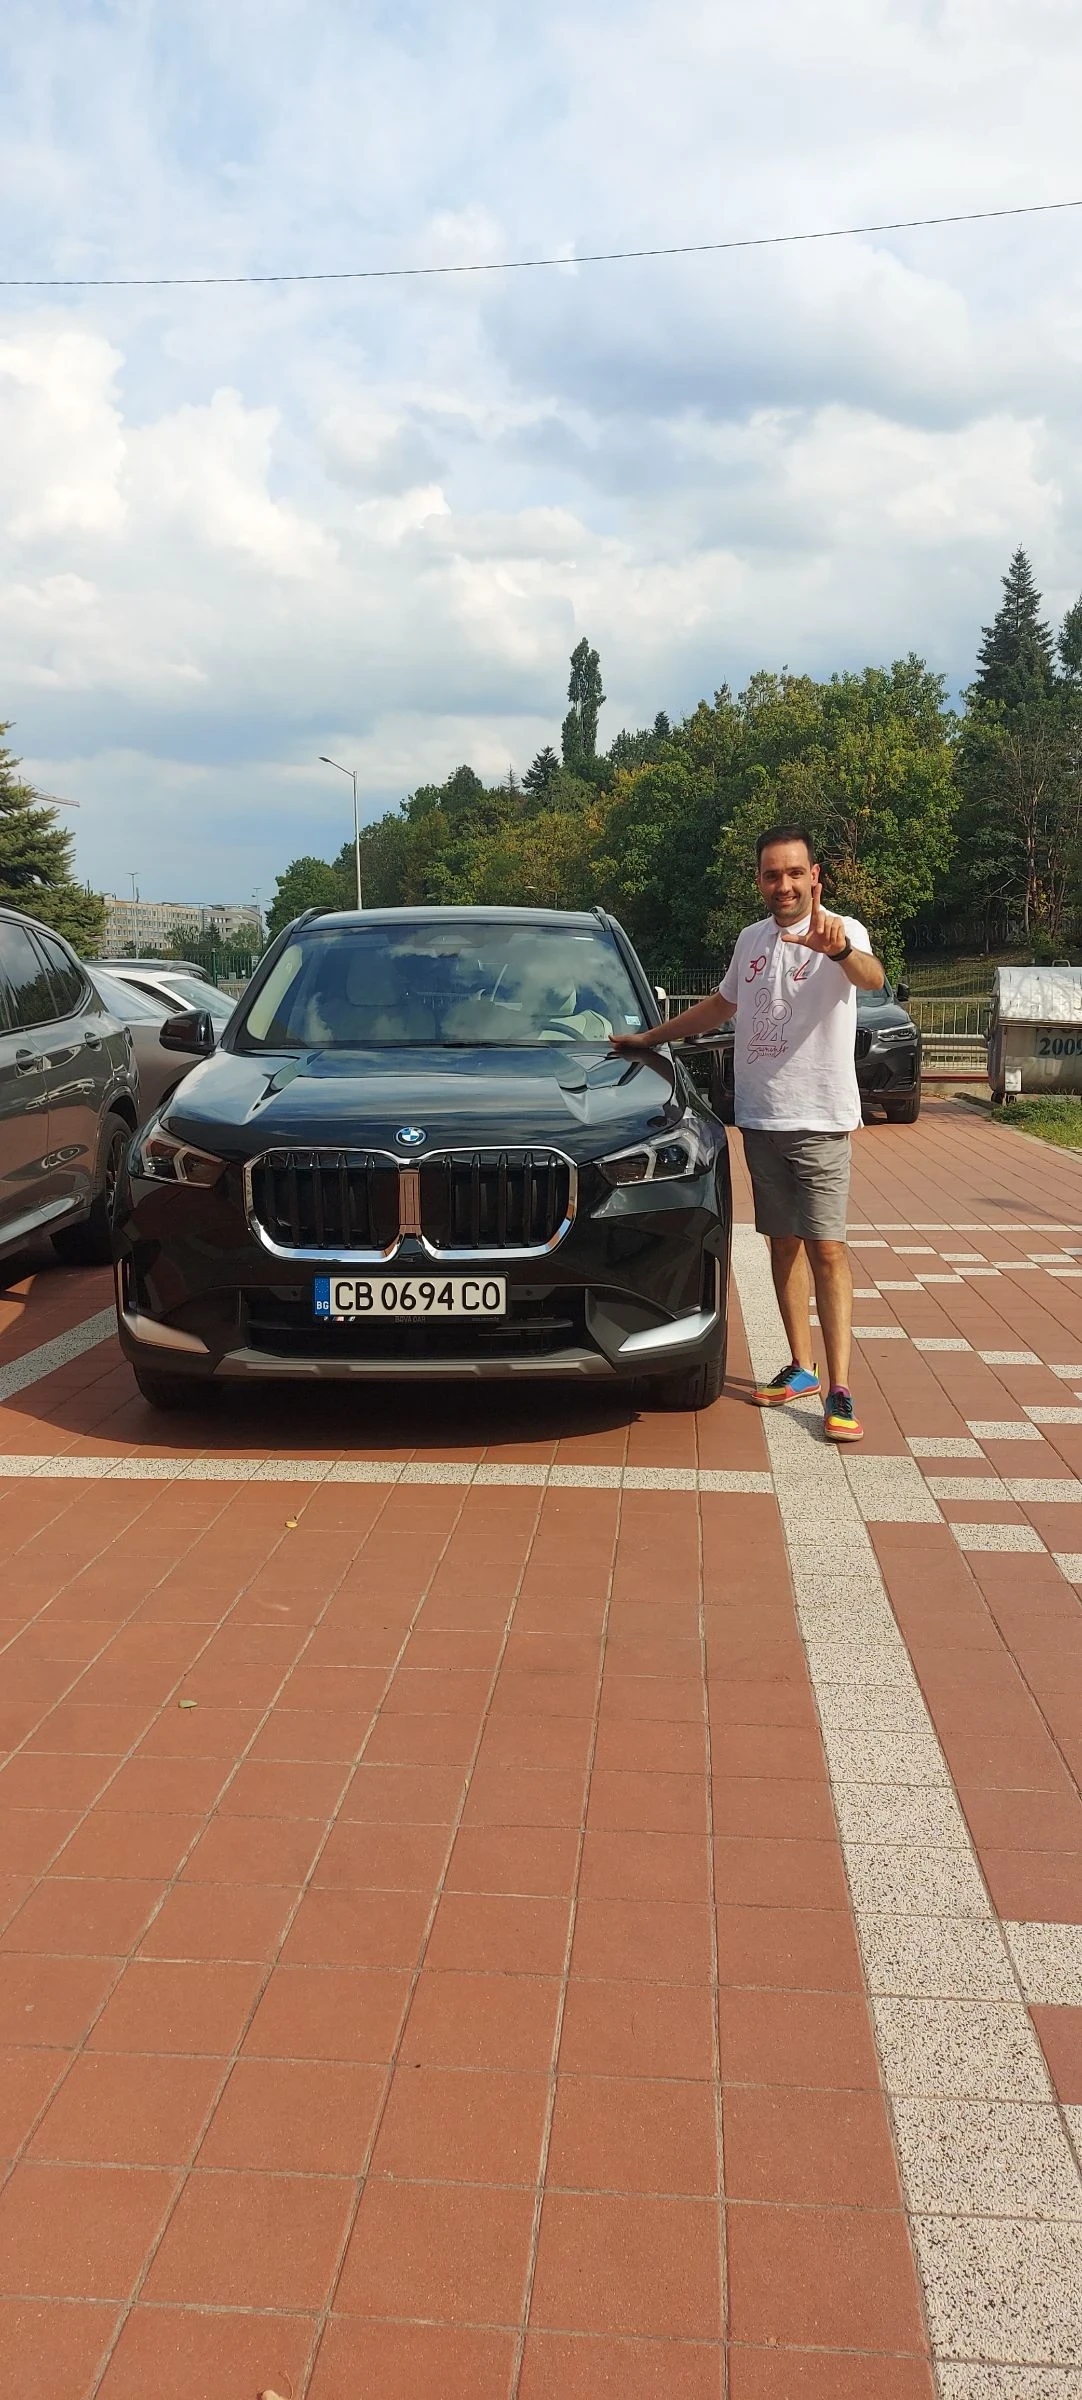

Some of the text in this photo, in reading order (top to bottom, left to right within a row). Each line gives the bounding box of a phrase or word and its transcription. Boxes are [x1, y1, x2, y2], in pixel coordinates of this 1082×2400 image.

[316, 1300, 329, 1310] BG
[334, 1281, 501, 1311] CB 0694 CO
